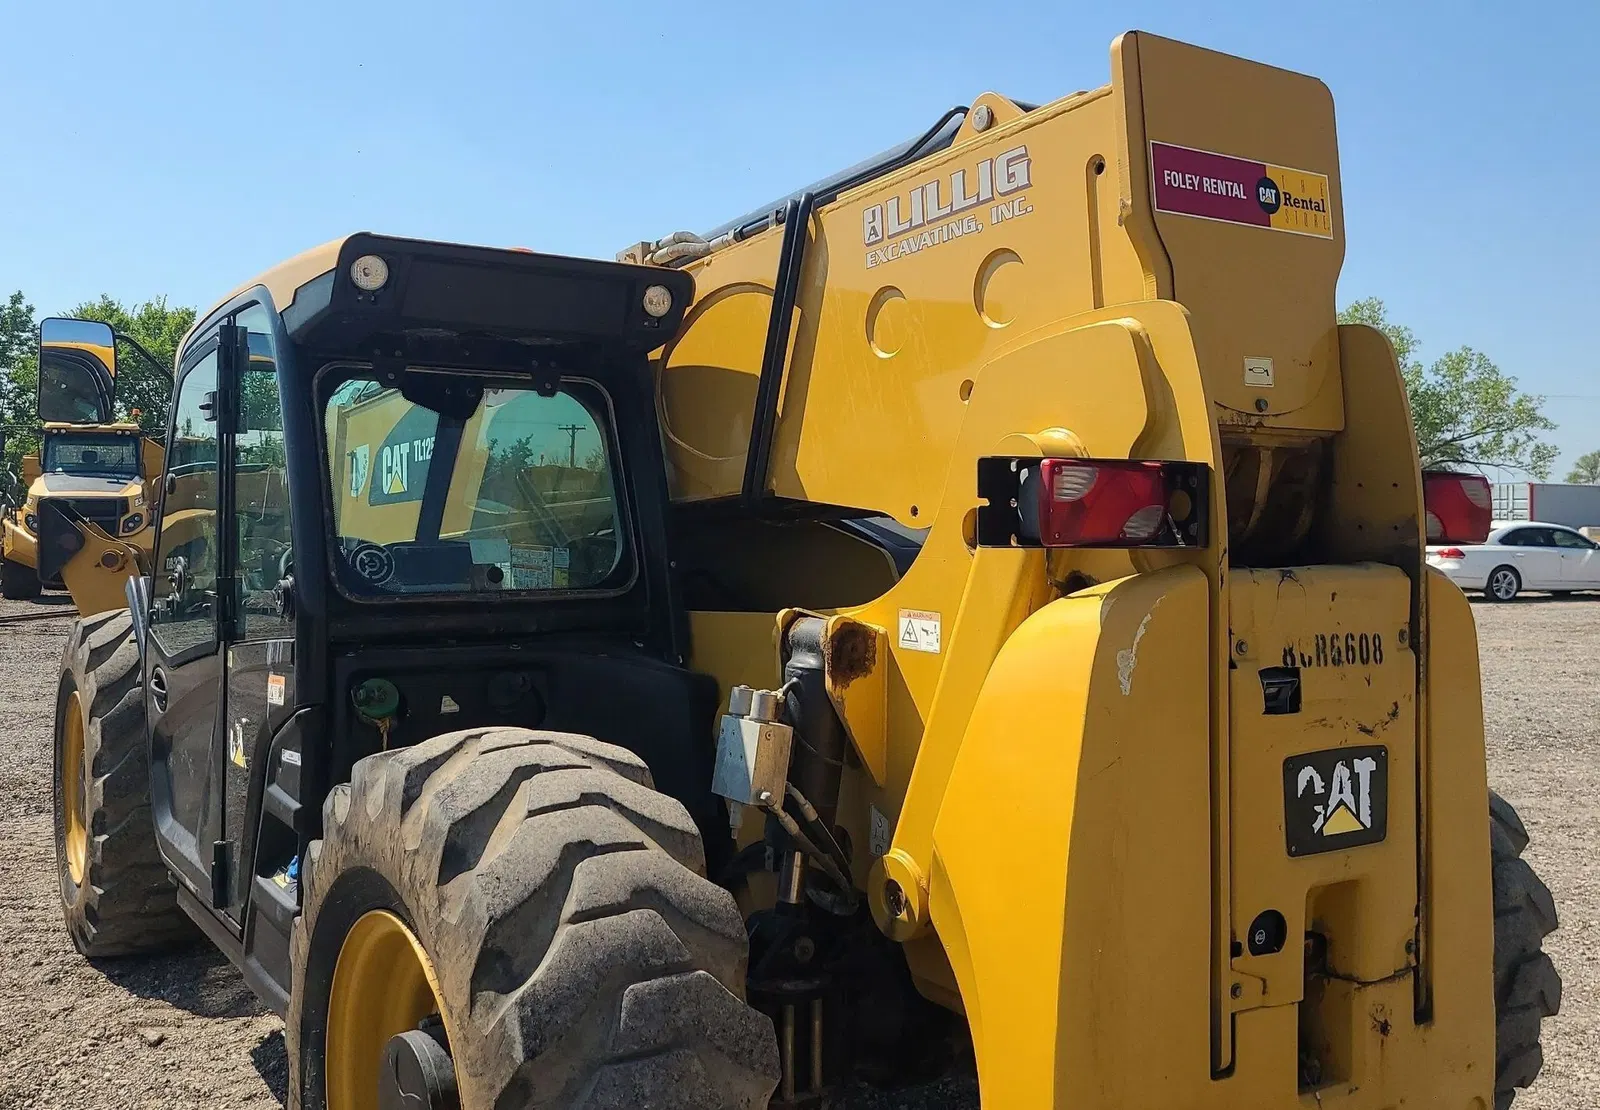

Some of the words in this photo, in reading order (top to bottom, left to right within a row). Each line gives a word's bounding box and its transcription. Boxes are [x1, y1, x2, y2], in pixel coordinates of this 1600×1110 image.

[886, 145, 1033, 239] LILLIG
[1164, 170, 1199, 191] FOLEY
[1203, 177, 1247, 200] RENTAL
[1259, 186, 1276, 205] CAT
[1282, 192, 1326, 213] Rental
[866, 214, 983, 269] EXCAVATING,
[990, 196, 1033, 225] INC.
[382, 442, 410, 494] CAT
